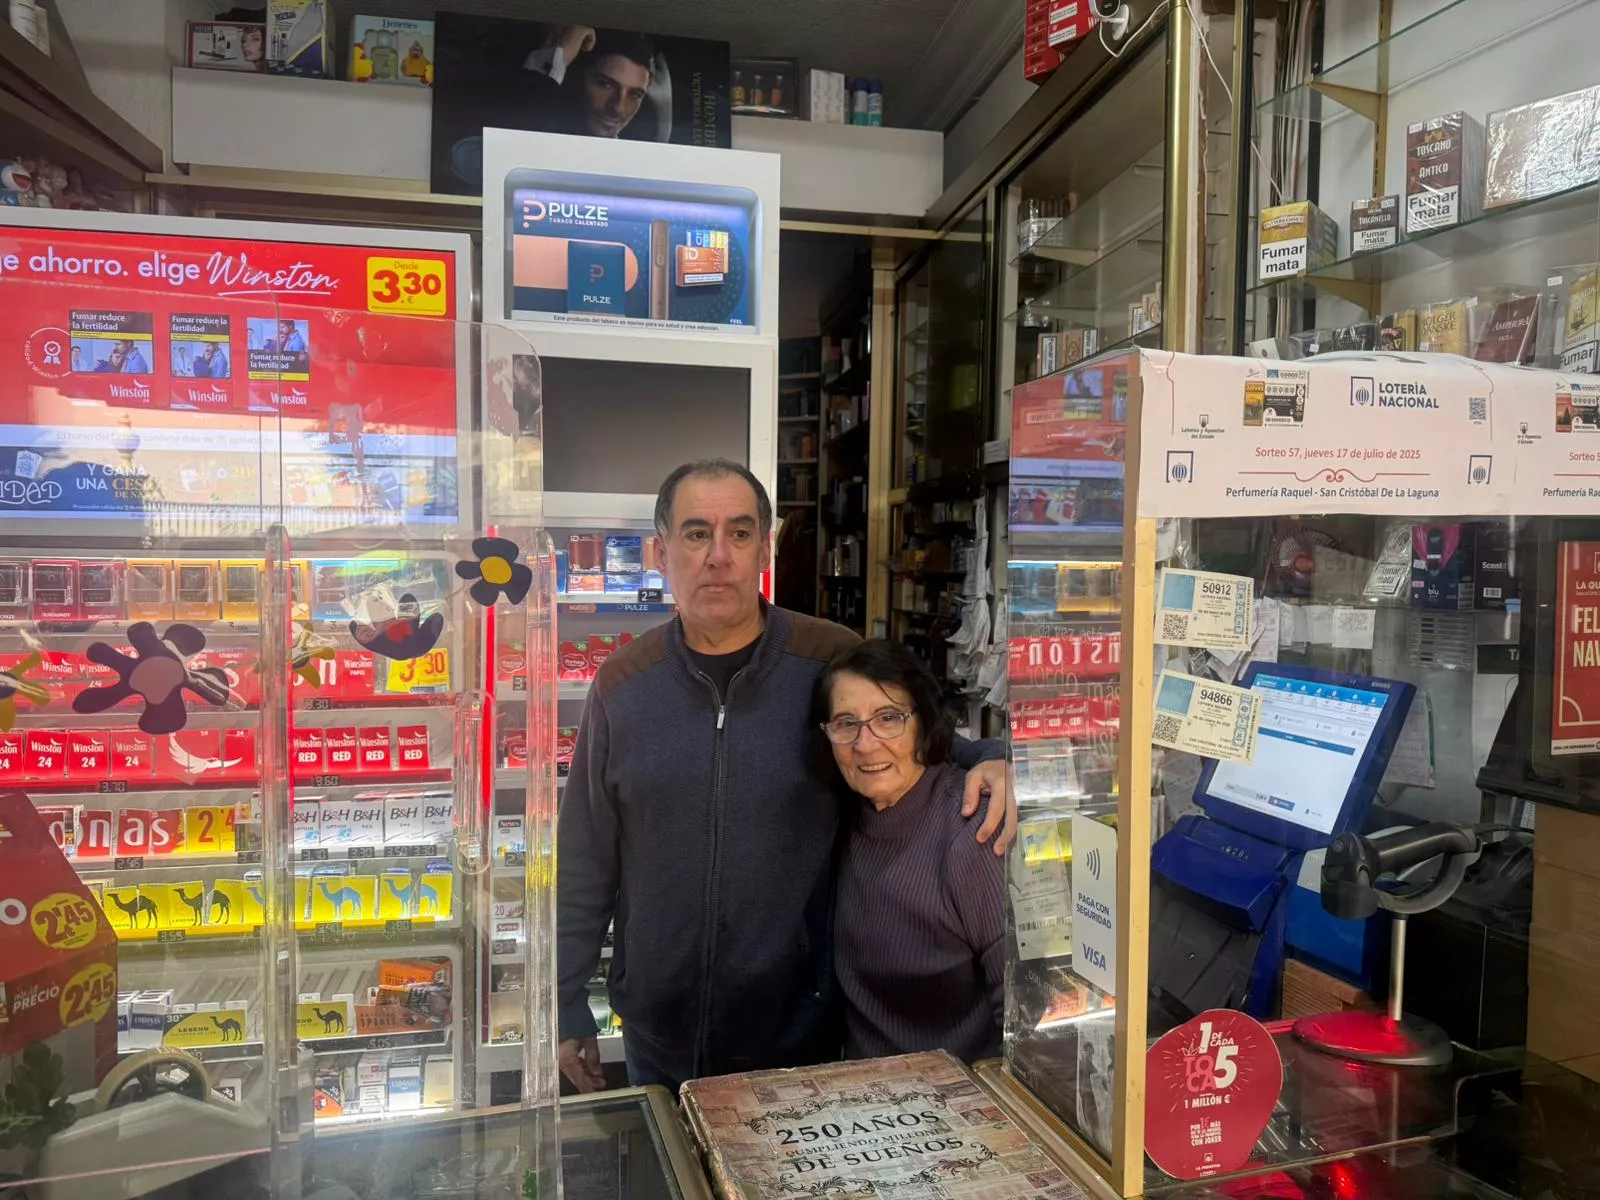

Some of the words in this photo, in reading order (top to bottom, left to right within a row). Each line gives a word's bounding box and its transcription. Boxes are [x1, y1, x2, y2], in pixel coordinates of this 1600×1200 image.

[1418, 162, 1449, 179] ANTICO
[1410, 188, 1457, 211] Fumar
[548, 202, 609, 221] PULZE
[1361, 230, 1388, 240] Fumar
[1364, 236, 1385, 245] mata
[1262, 244, 1305, 260] Fumar
[29, 246, 129, 276] ahorro.
[138, 251, 200, 286] elige
[1265, 259, 1300, 274] mata
[583, 294, 611, 305] PULZE
[72, 312, 98, 321] Fumar
[99, 314, 126, 323] reduce
[172, 316, 195, 325] Fumar
[82, 322, 119, 331] fertilidad
[110, 384, 150, 399] Winston
[188, 389, 228, 403] Winston
[1378, 396, 1440, 409] NACIONAL
[1254, 446, 1286, 458] Sorteo
[1287, 447, 1303, 460] 57,
[1304, 448, 1335, 460] jueves
[1337, 448, 1348, 458] 17
[1350, 448, 1362, 458] de
[1363, 448, 1384, 461] julio
[1386, 449, 1397, 459] de
[1399, 449, 1421, 460] 2025
[1569, 450, 1594, 461] Sorteo
[76, 478, 108, 490] UNA
[1225, 486, 1279, 498] Perfumería
[1280, 487, 1313, 500] Raquel
[1329, 488, 1347, 498] San
[1348, 487, 1389, 499] Cristóbal
[1390, 488, 1404, 498] De
[1406, 488, 1416, 498] La
[1417, 488, 1450, 501] Laguna
[1543, 487, 1586, 499] Perfumería
[1202, 581, 1232, 596] 50912
[1576, 581, 1587, 590] LA
[42, 660, 73, 674] Winston
[1200, 688, 1233, 706] 94866
[116, 740, 147, 752] Winston
[326, 737, 356, 747] Winston
[359, 737, 389, 746] Winston
[397, 735, 427, 746] Winston
[31, 741, 62, 754] Winston
[72, 742, 104, 754] Winston
[298, 752, 317, 762] RED
[332, 751, 351, 761] RED
[366, 750, 385, 761] RED
[404, 749, 423, 760] RED
[38, 756, 52, 768] 24
[81, 757, 96, 768] 24
[125, 756, 140, 767] 24
[322, 808, 350, 822] B&H
[353, 808, 381, 821] B&H
[390, 806, 418, 819] B&H
[424, 805, 453, 818] B&H
[1077, 892, 1096, 909] PAGA
[1095, 903, 1110, 917] CON
[1076, 903, 1112, 930] SEGURIDAD
[1082, 943, 1107, 971] VISA
[12, 983, 60, 1014] PRECIO
[1198, 1021, 1213, 1054] 1
[1211, 1031, 1223, 1039] DE
[1209, 1037, 1235, 1047] CADA
[1213, 1045, 1239, 1089] 5
[1184, 1099, 1188, 1109] 1
[1192, 1094, 1222, 1108] MILLÓN
[1224, 1094, 1231, 1104] €
[775, 1122, 844, 1146] 250
[851, 1110, 942, 1136] AÑOS
[1204, 1135, 1222, 1145] JOKER
[785, 1137, 879, 1158] CUMPLIENDO
[792, 1155, 837, 1175] DE
[846, 1136, 964, 1167] SUEÑOS
